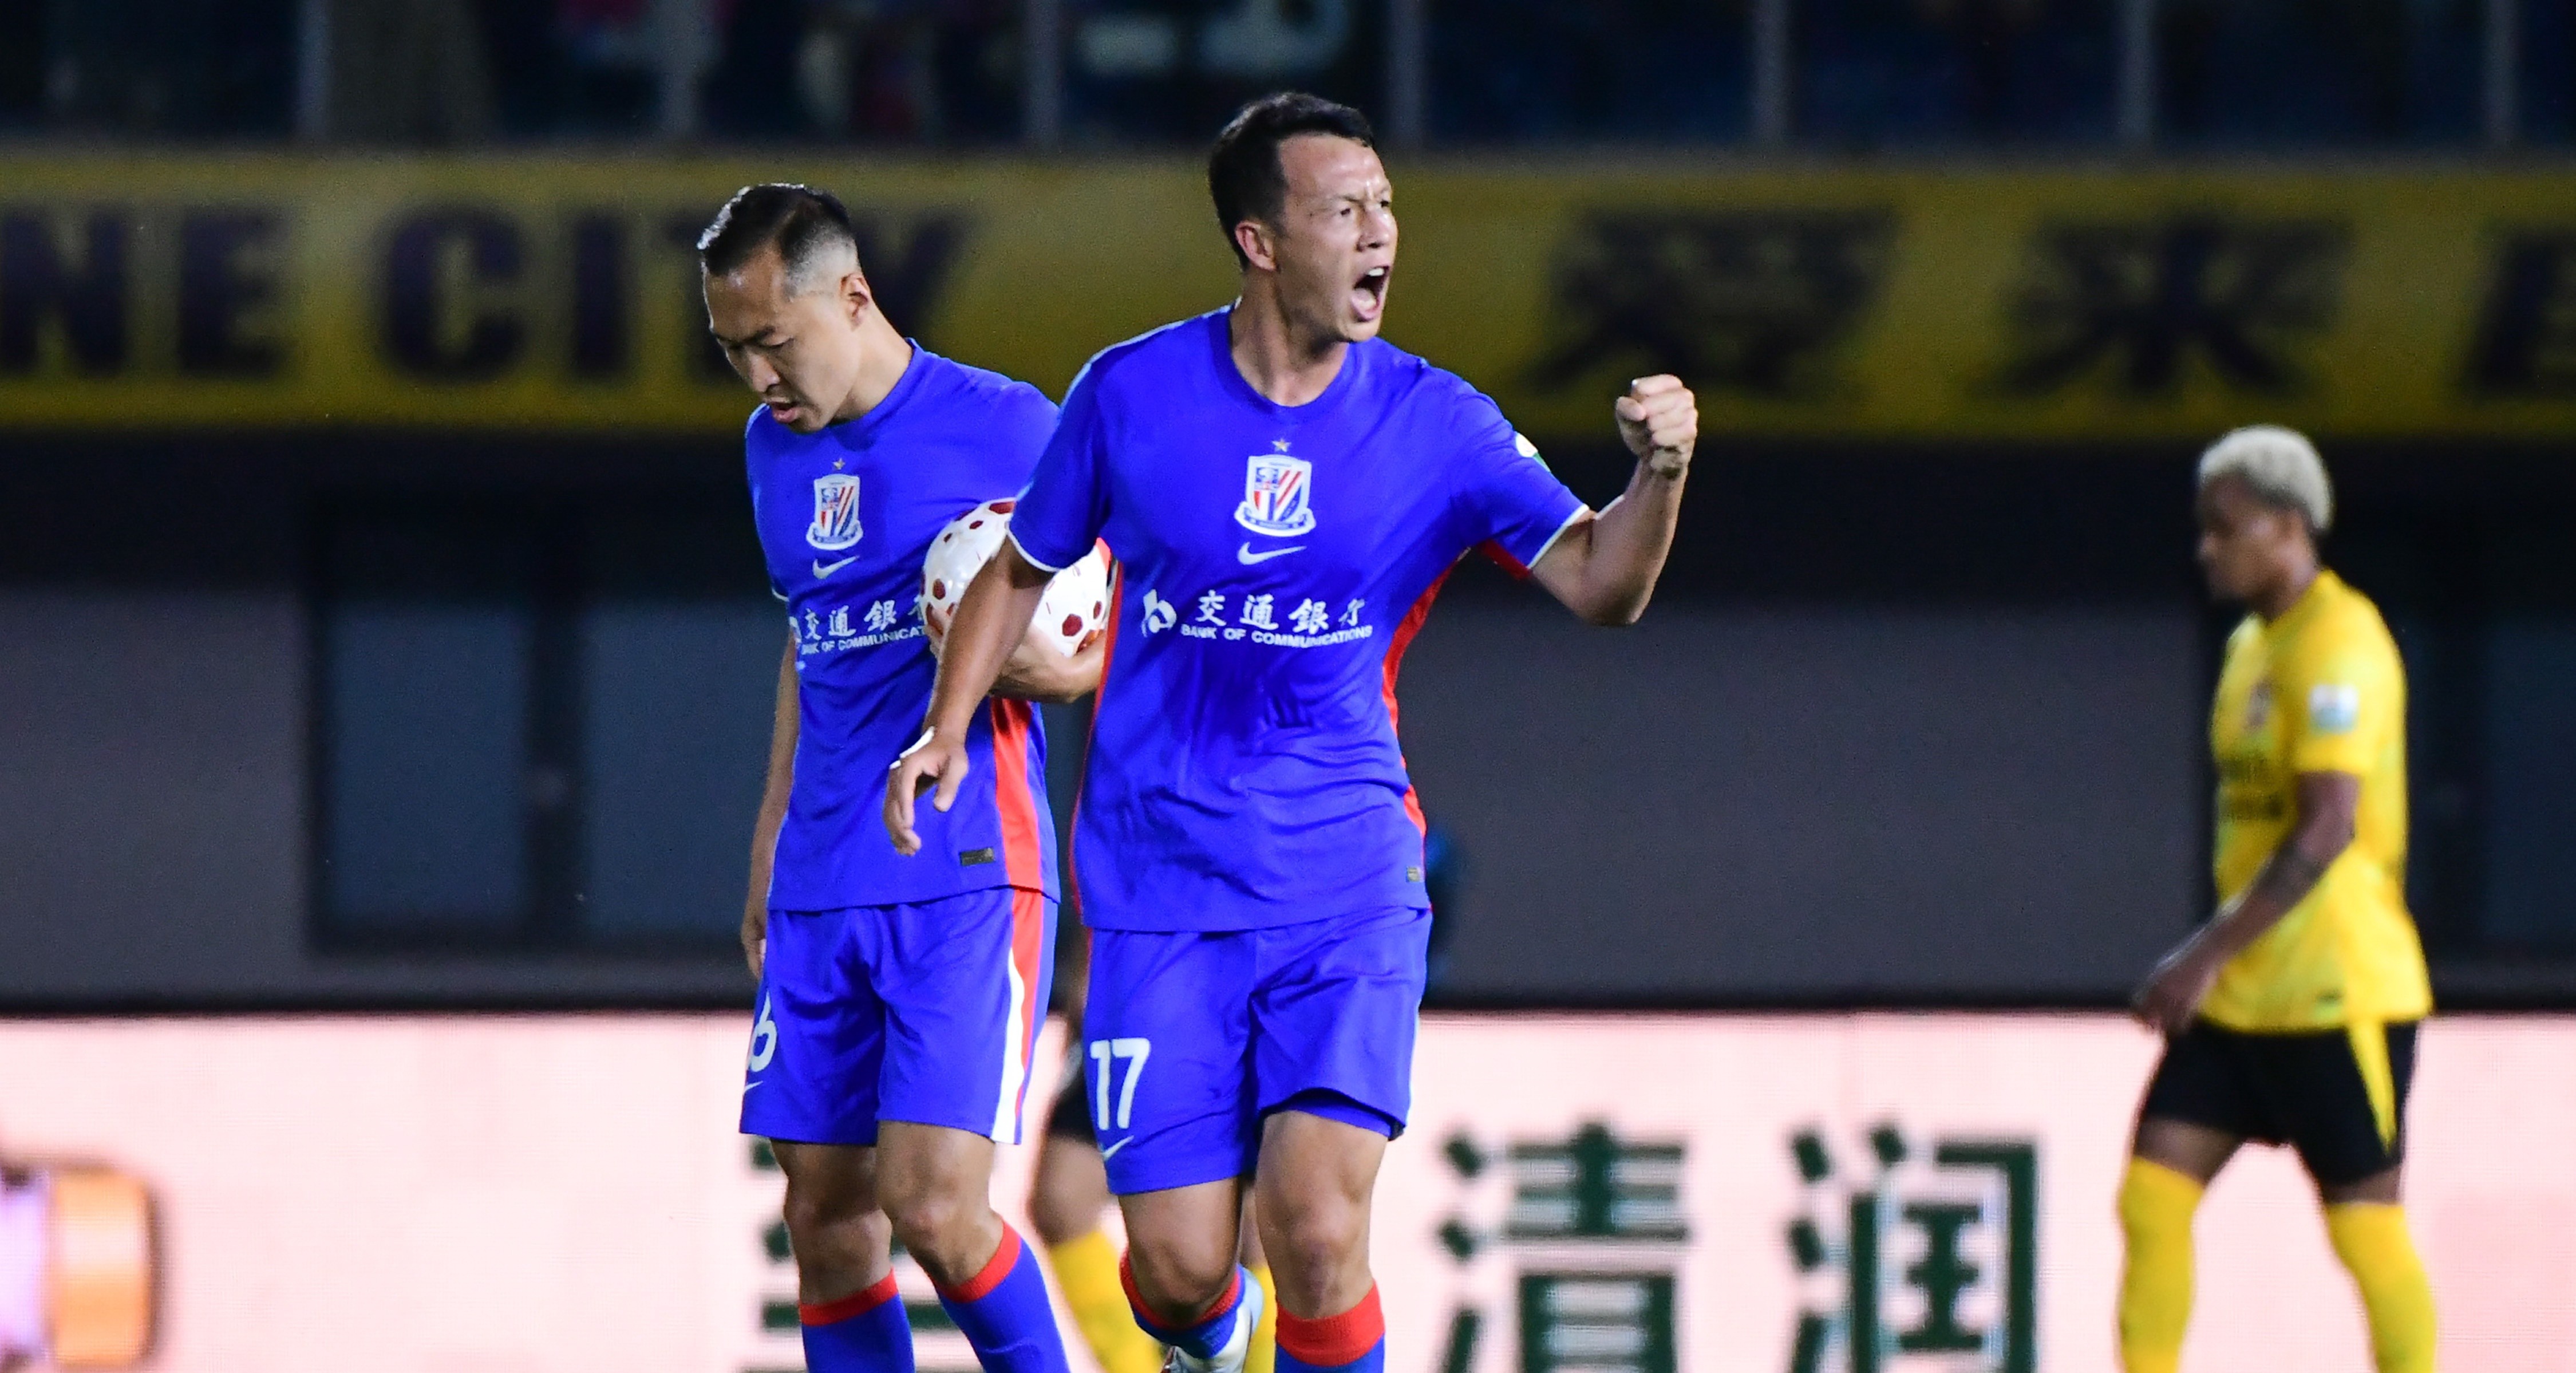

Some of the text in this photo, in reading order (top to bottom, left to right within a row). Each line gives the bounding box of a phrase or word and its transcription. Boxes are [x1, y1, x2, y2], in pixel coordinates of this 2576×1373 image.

[1180, 624, 1373, 649] BANK OF COMMUNICATIONS
[1090, 1037, 1151, 1130] 17
